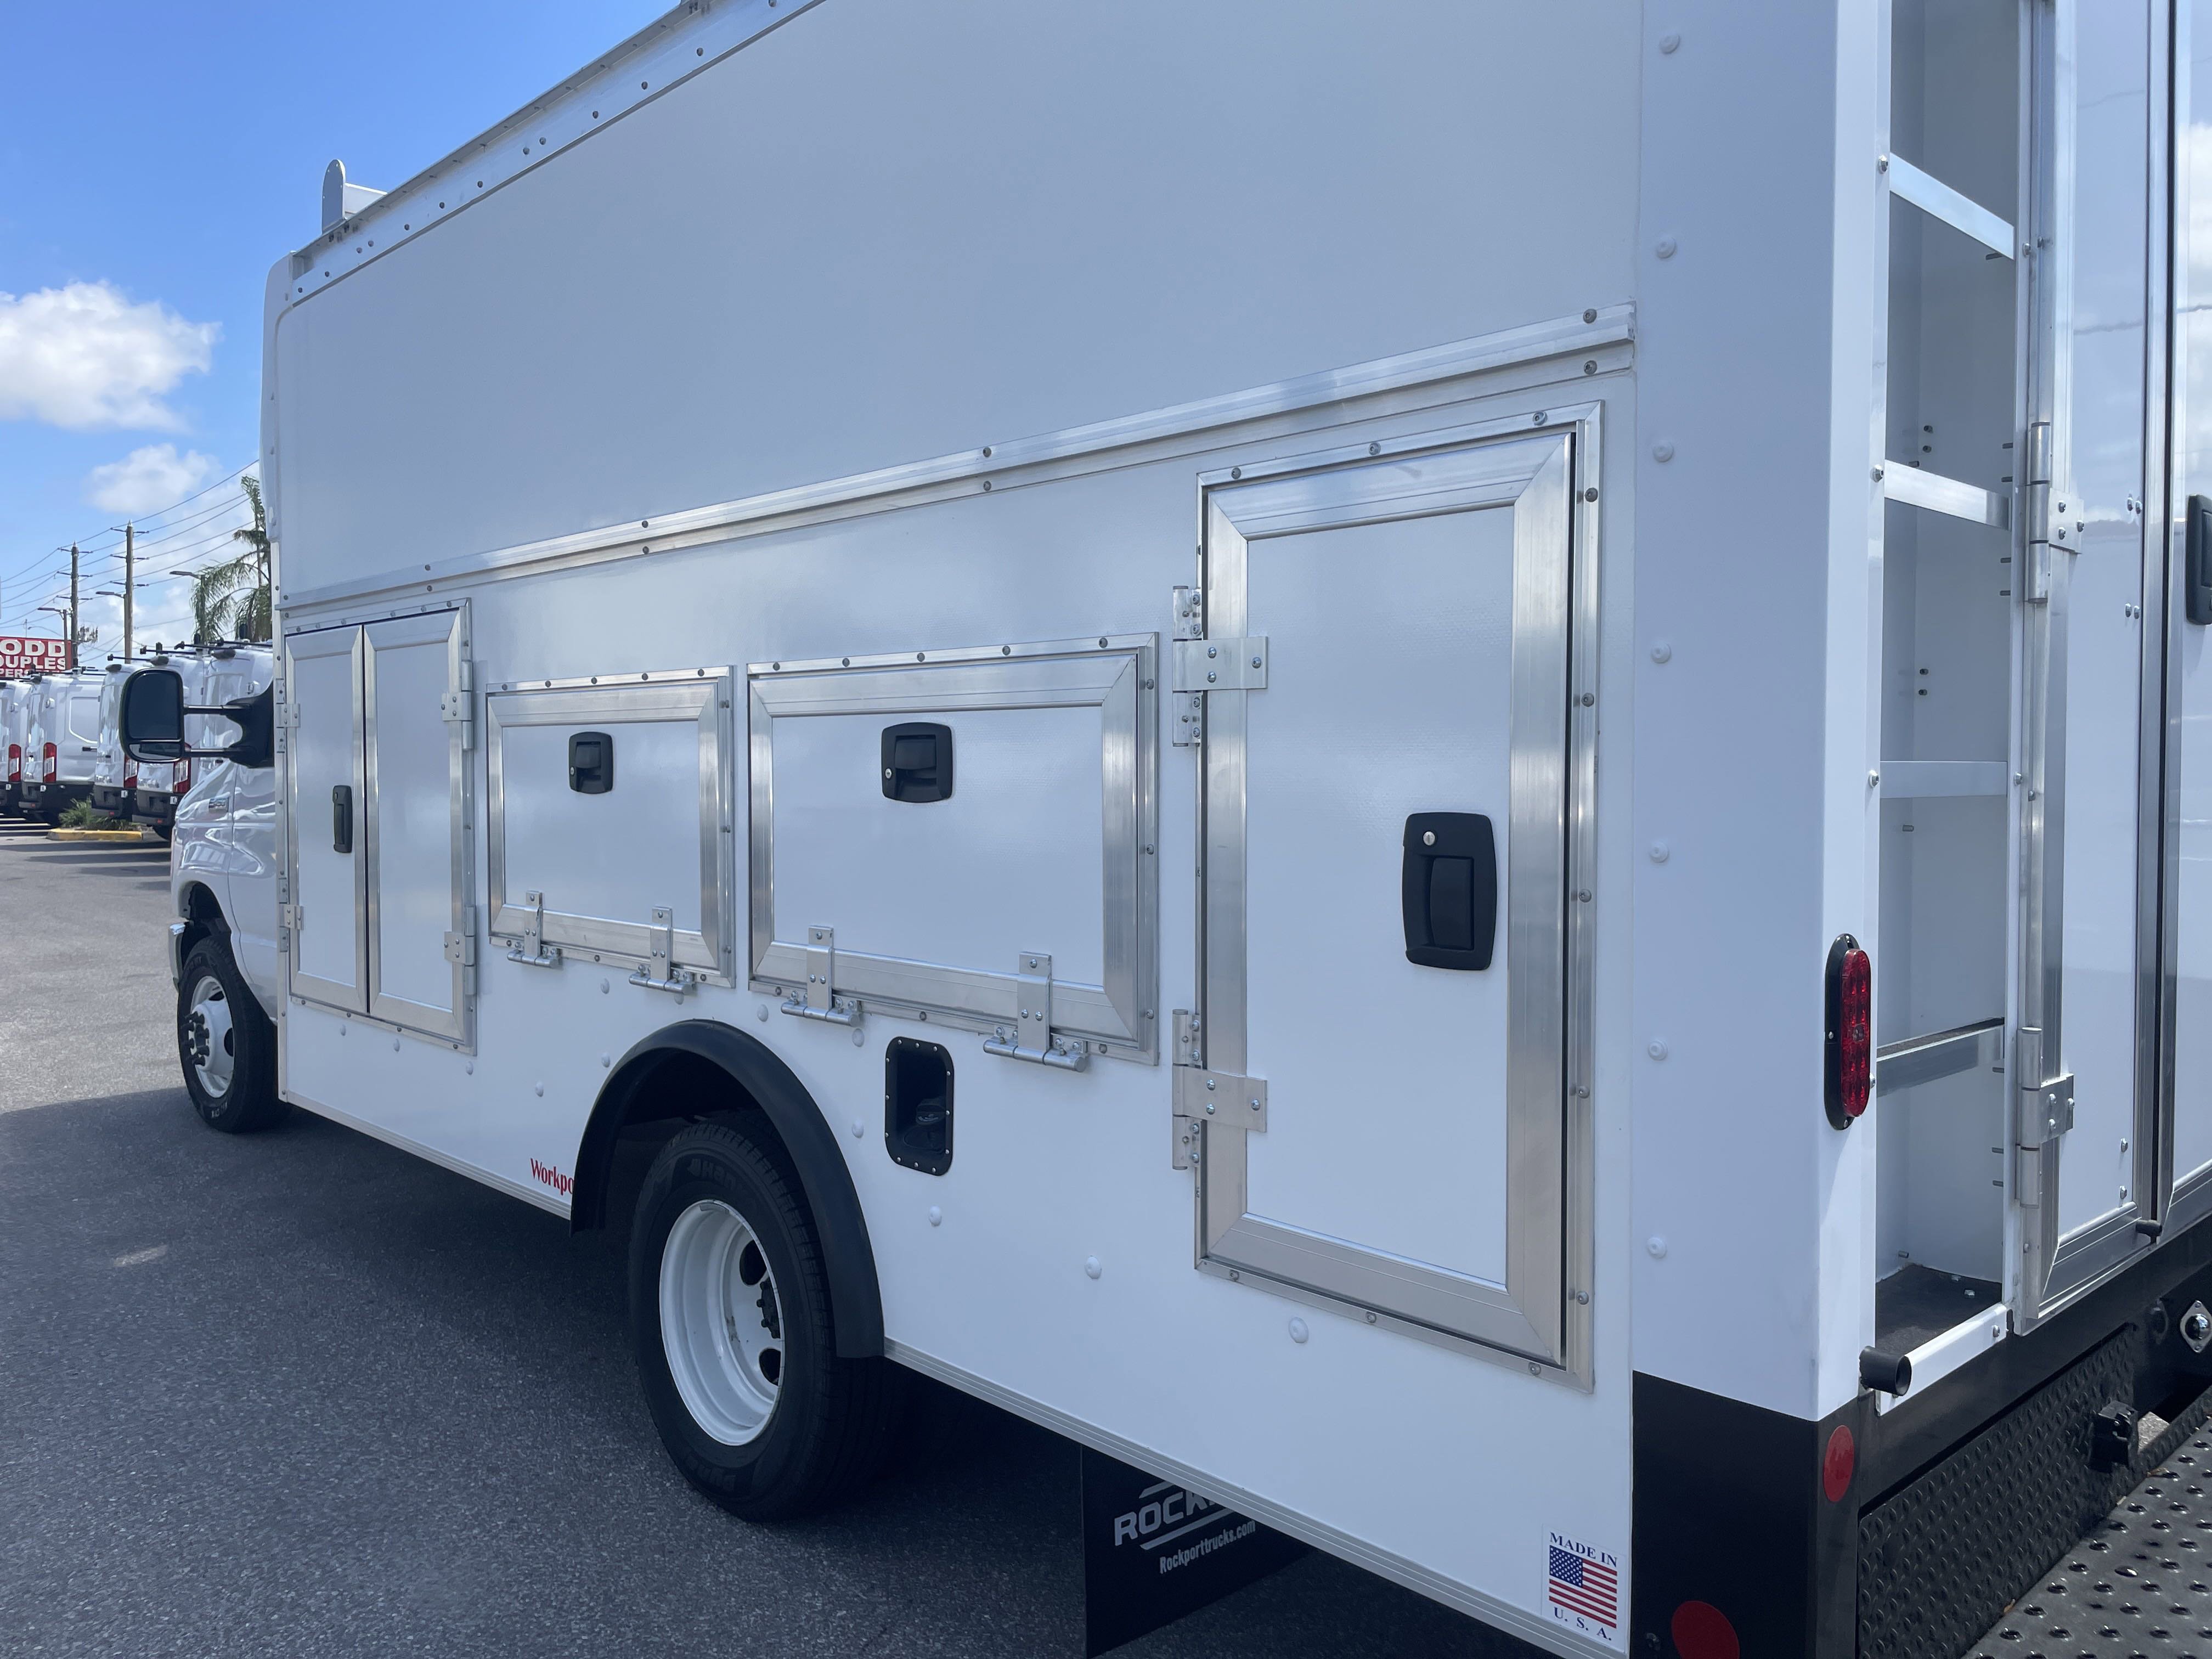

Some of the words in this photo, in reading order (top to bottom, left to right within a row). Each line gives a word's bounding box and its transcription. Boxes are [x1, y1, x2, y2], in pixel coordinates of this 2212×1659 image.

[1160, 1520, 1256, 1574] Rockporttrucks.com
[1550, 1531, 1596, 1559] MADE
[1600, 1551, 1617, 1567] IN
